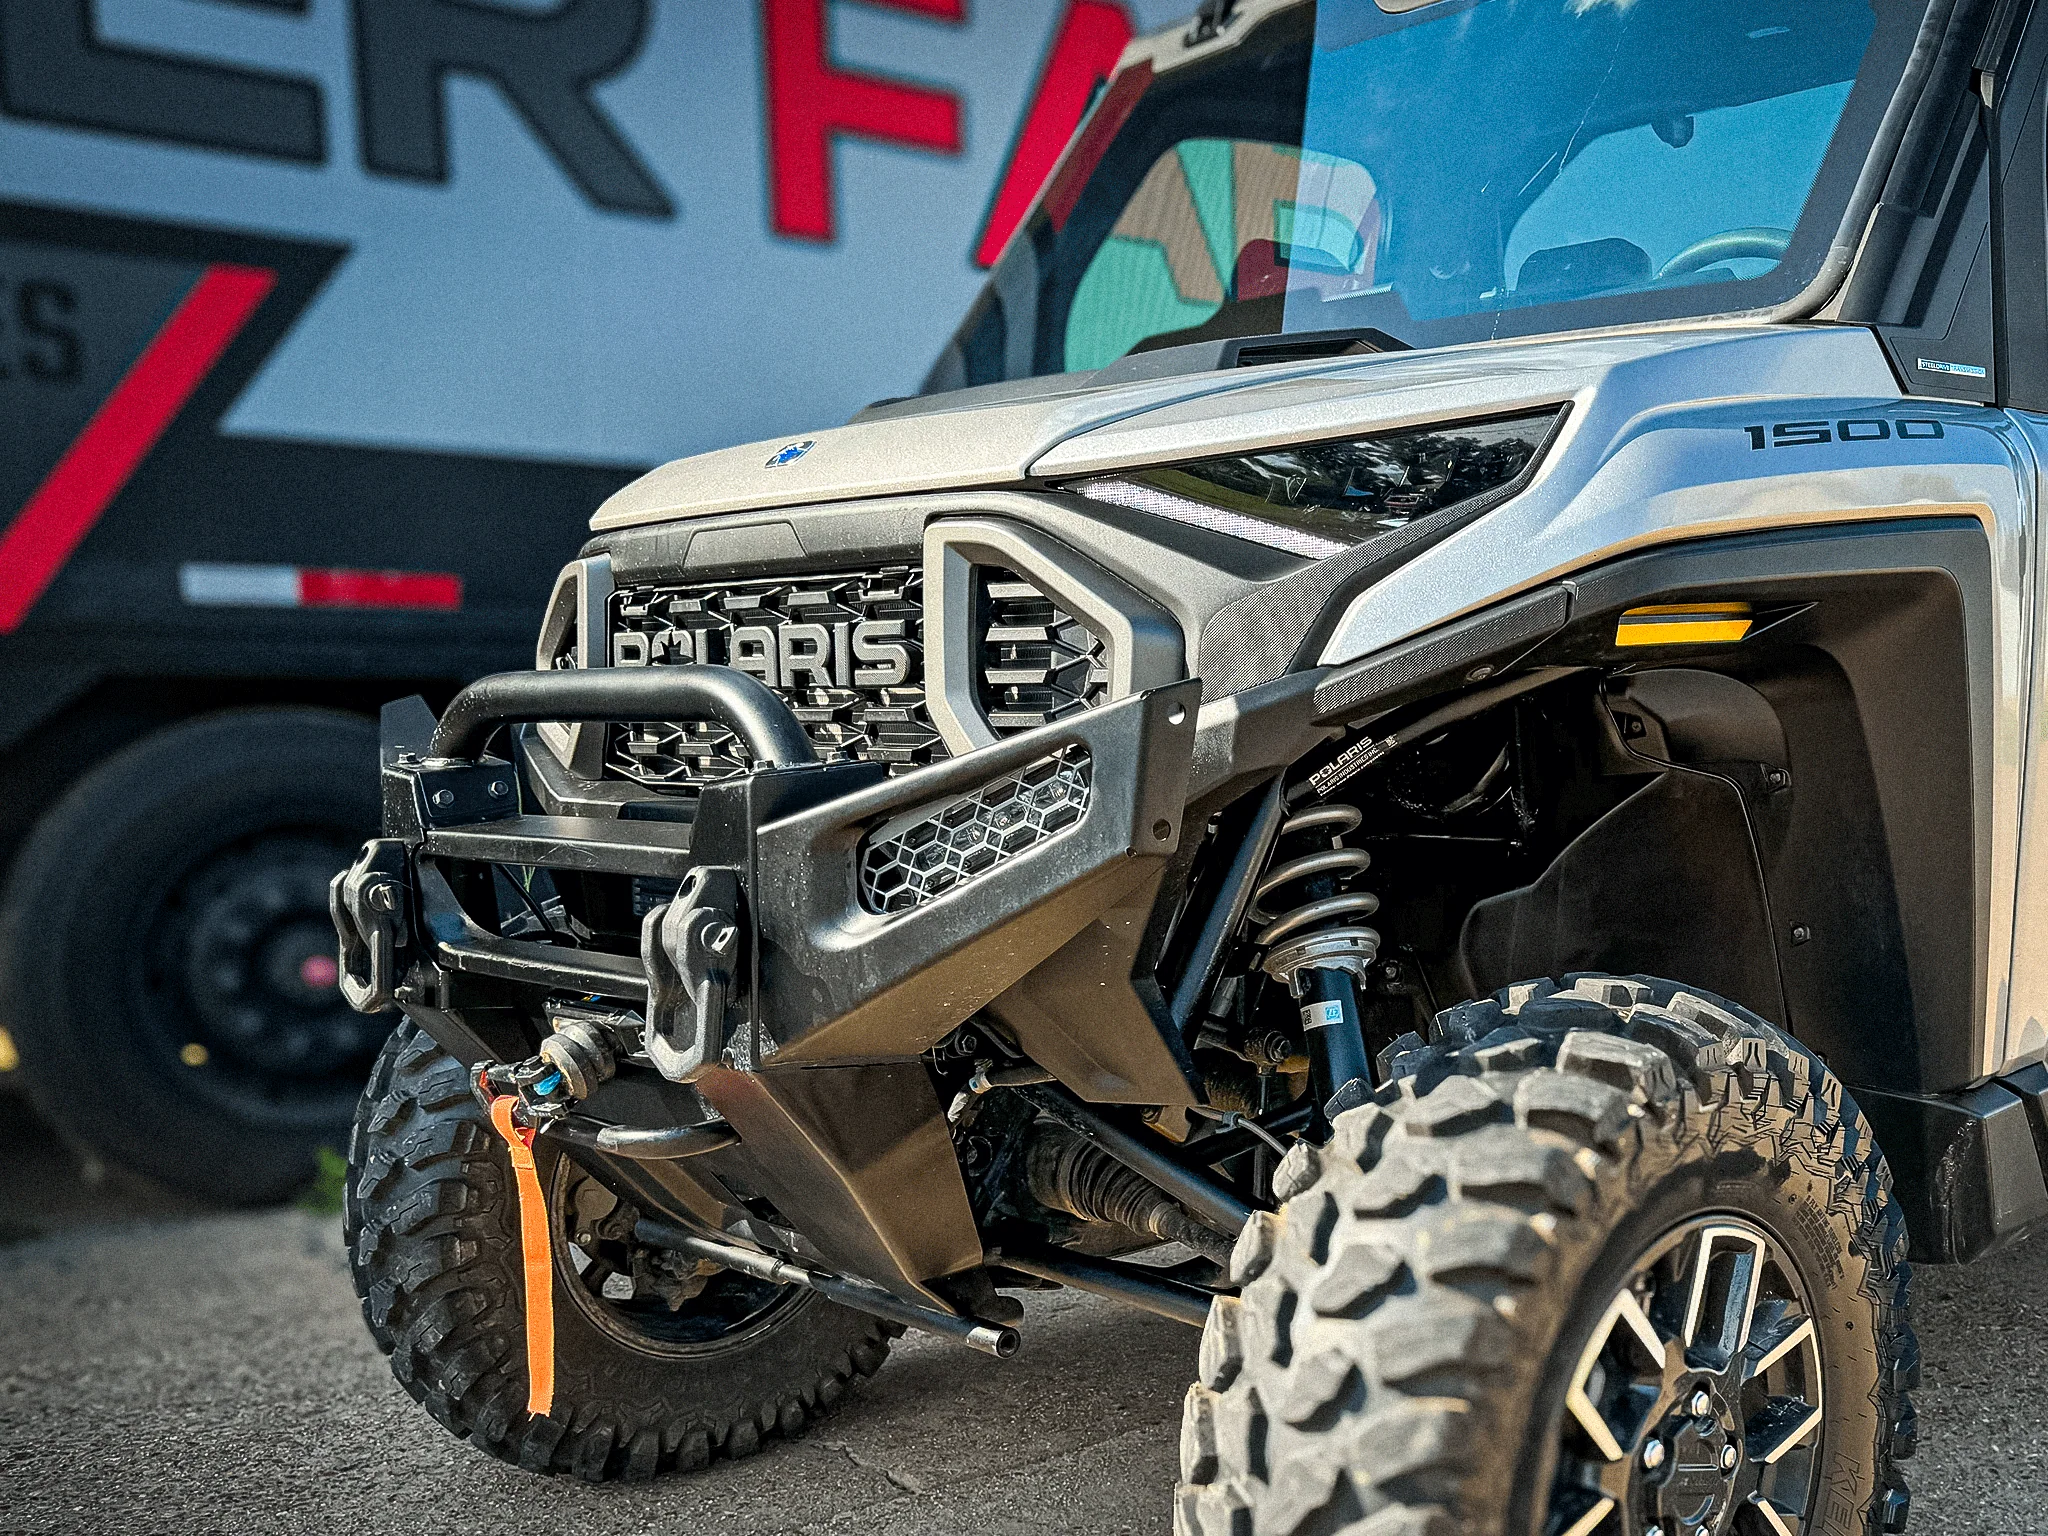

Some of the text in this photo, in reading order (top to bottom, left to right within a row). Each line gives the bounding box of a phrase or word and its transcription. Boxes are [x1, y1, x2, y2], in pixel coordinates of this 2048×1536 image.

[1744, 419, 1945, 451] 1500
[1308, 736, 1373, 786] POLARIS
[1316, 775, 1340, 794] POLARIS
[1820, 1451, 1861, 1536] KE
